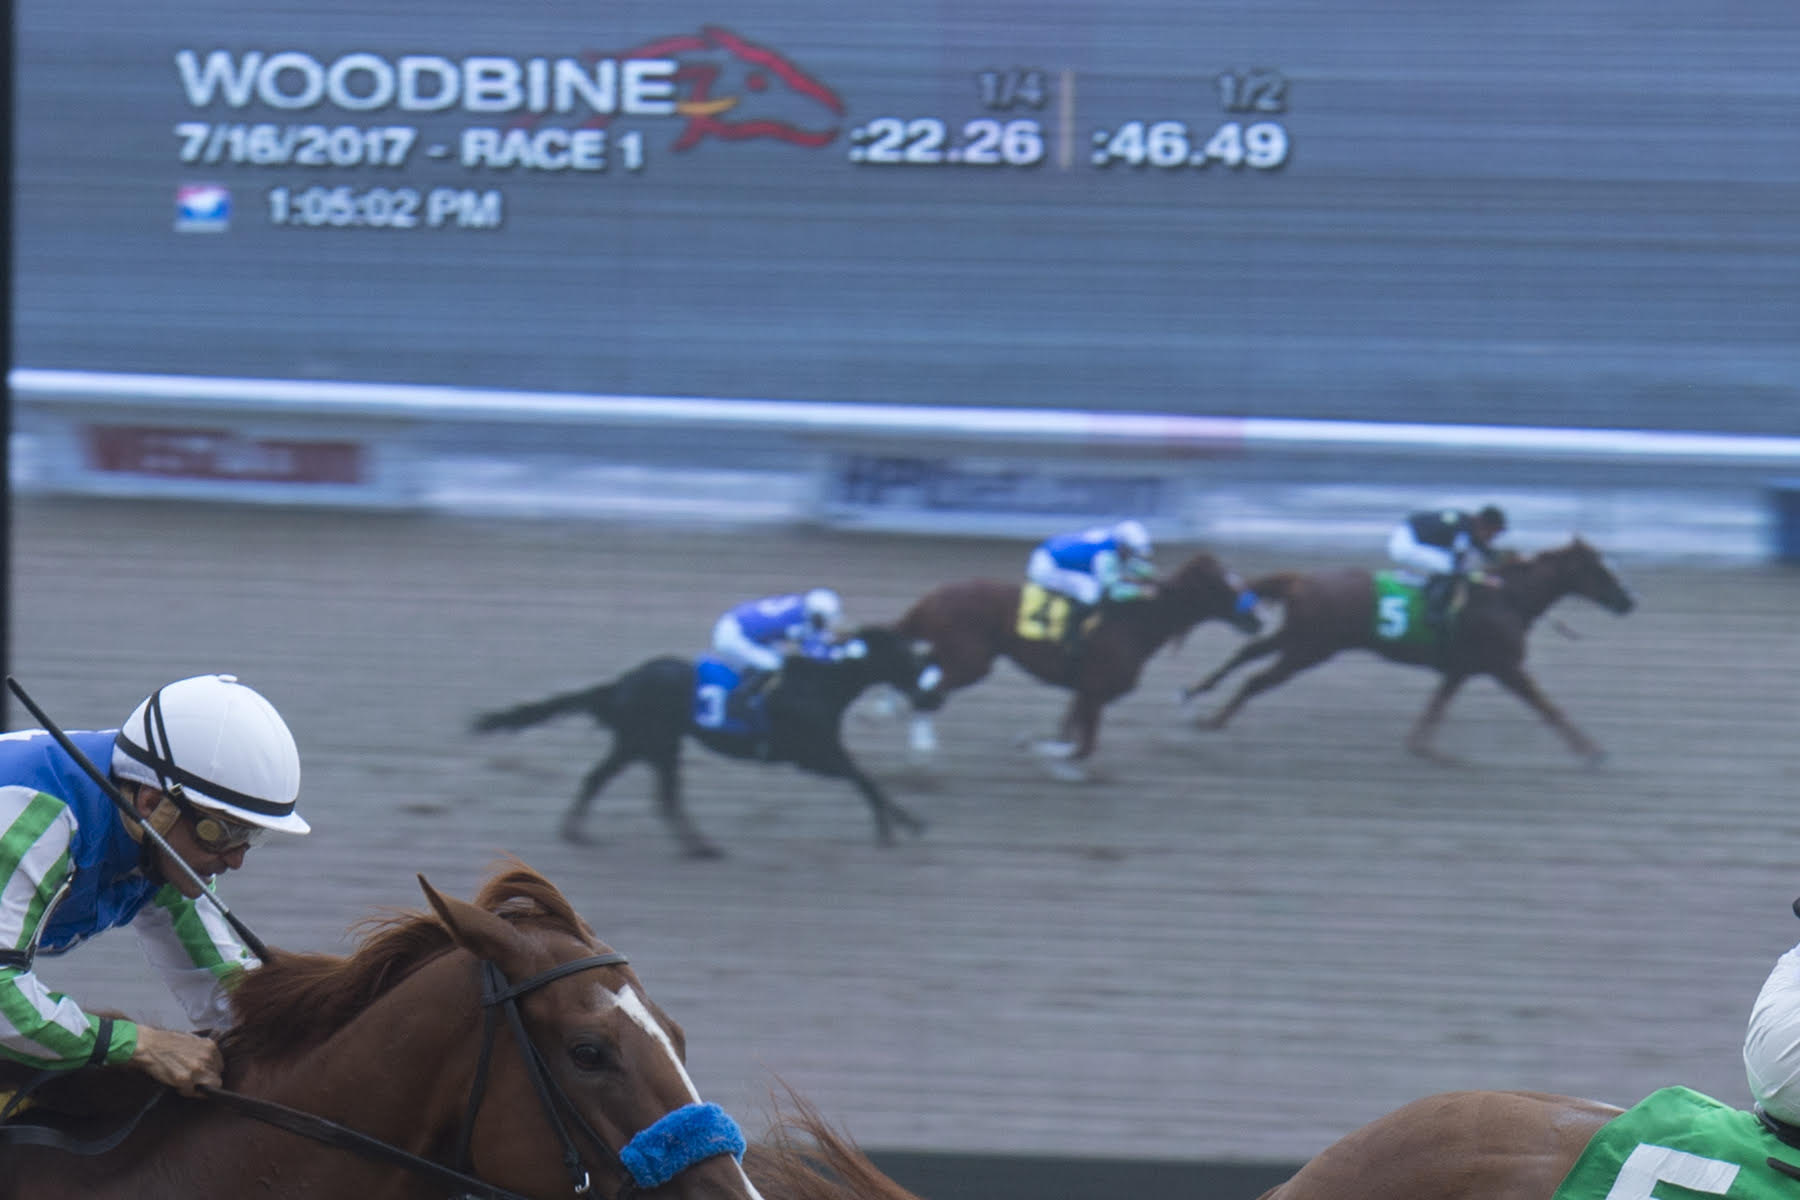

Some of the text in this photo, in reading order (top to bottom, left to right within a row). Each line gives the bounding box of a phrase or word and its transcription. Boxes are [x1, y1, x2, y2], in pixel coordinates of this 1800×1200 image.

[174, 50, 680, 116] WOODBINE
[979, 71, 1045, 109] 1/4
[1216, 71, 1288, 113] 1/2
[174, 123, 418, 168] 7/16/2017
[461, 128, 607, 171] RACE
[619, 131, 644, 170] 1
[849, 118, 1045, 165] :22.26
[1092, 122, 1289, 168] :46.49
[268, 188, 502, 229] 1:05:02 PM
[1377, 594, 1410, 637] 5
